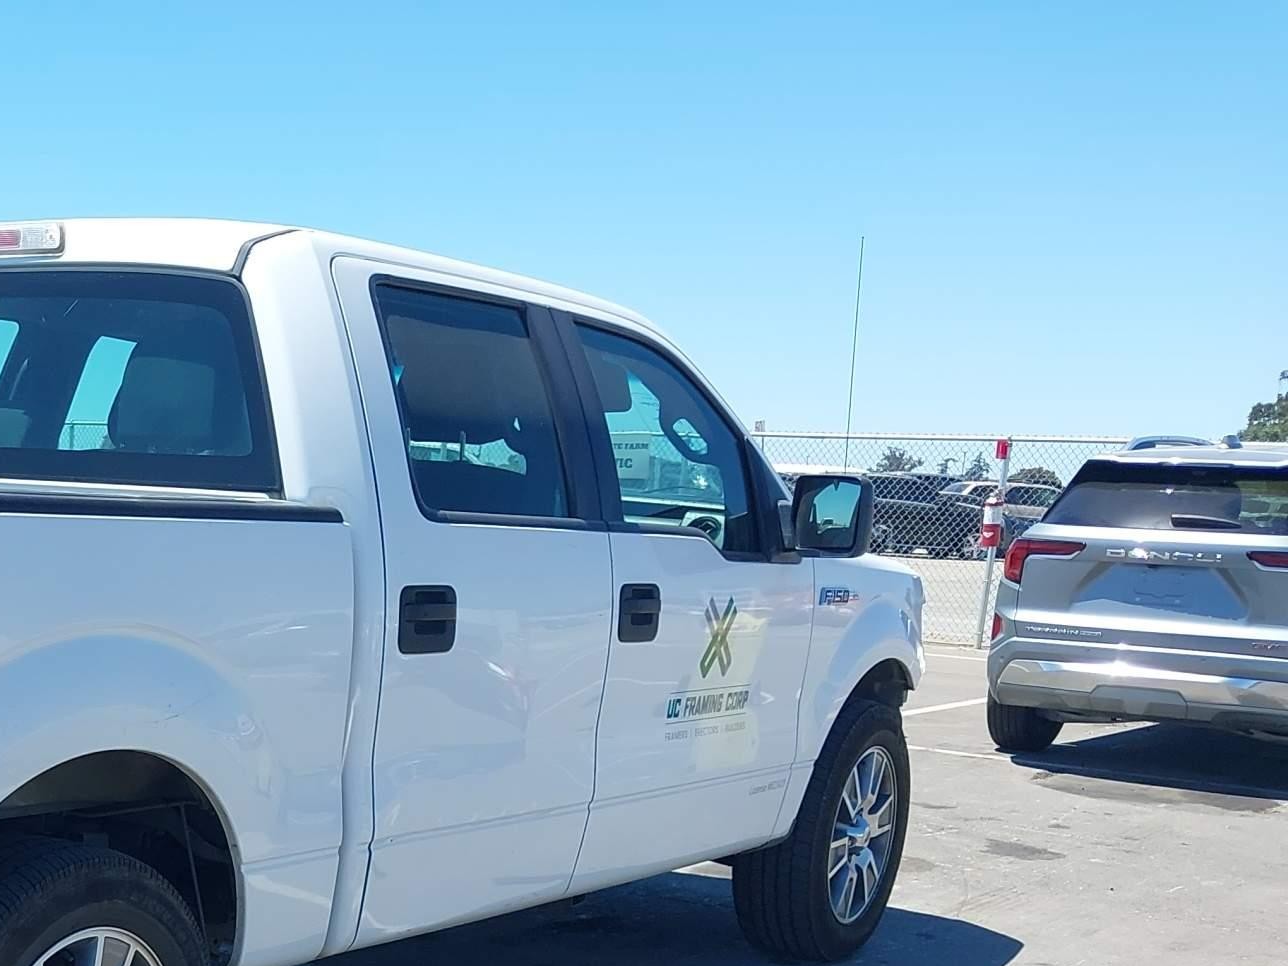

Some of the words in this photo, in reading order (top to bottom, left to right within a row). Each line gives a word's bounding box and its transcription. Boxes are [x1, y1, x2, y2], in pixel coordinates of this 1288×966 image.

[1106, 547, 1223, 562] DNALI
[666, 698, 682, 719] UC
[683, 693, 724, 718] FRAMING
[725, 690, 749, 712] CORP
